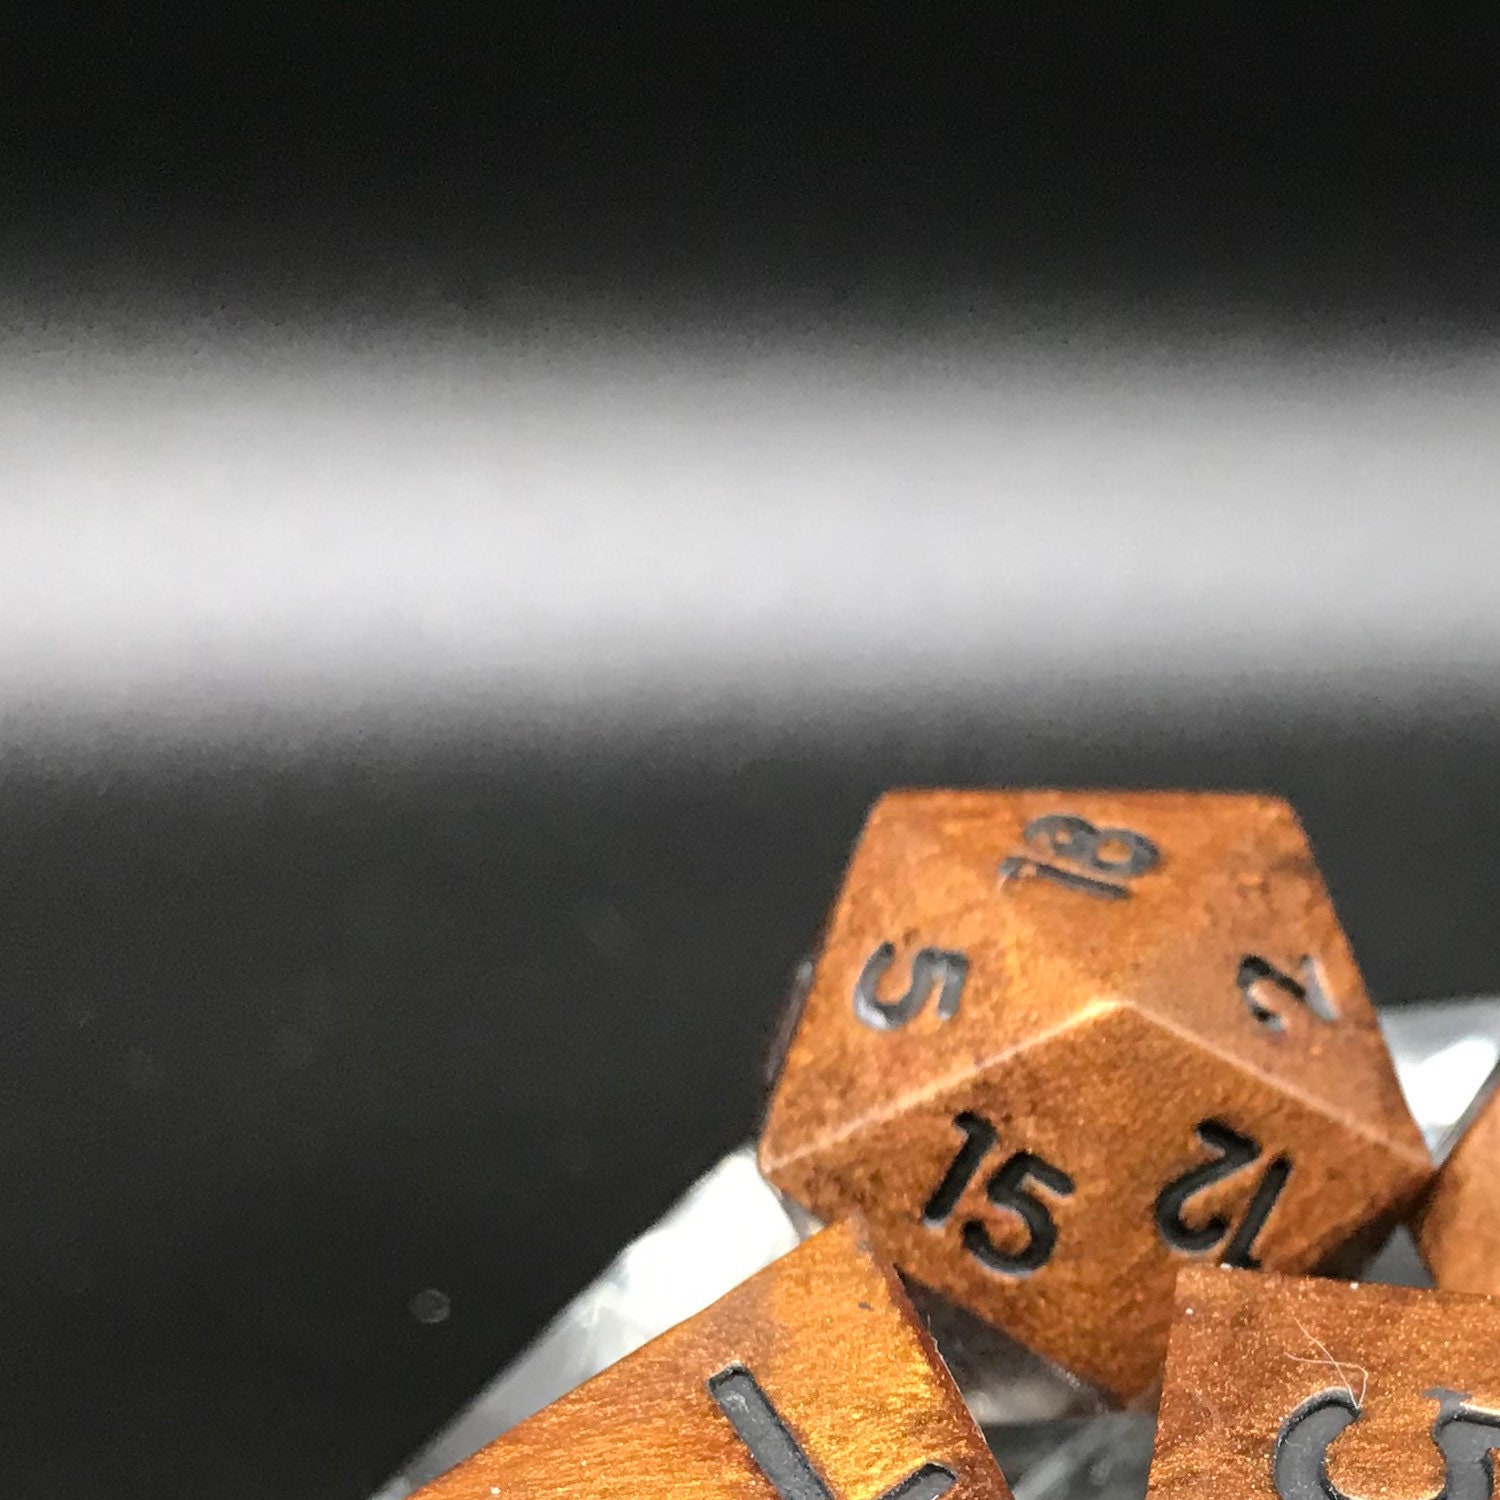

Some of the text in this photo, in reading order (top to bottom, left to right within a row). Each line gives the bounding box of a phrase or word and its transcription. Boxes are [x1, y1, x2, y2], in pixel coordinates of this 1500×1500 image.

[1000, 812, 1160, 900] 18
[853, 940, 970, 1031] 5
[921, 1110, 1076, 1277] 15
